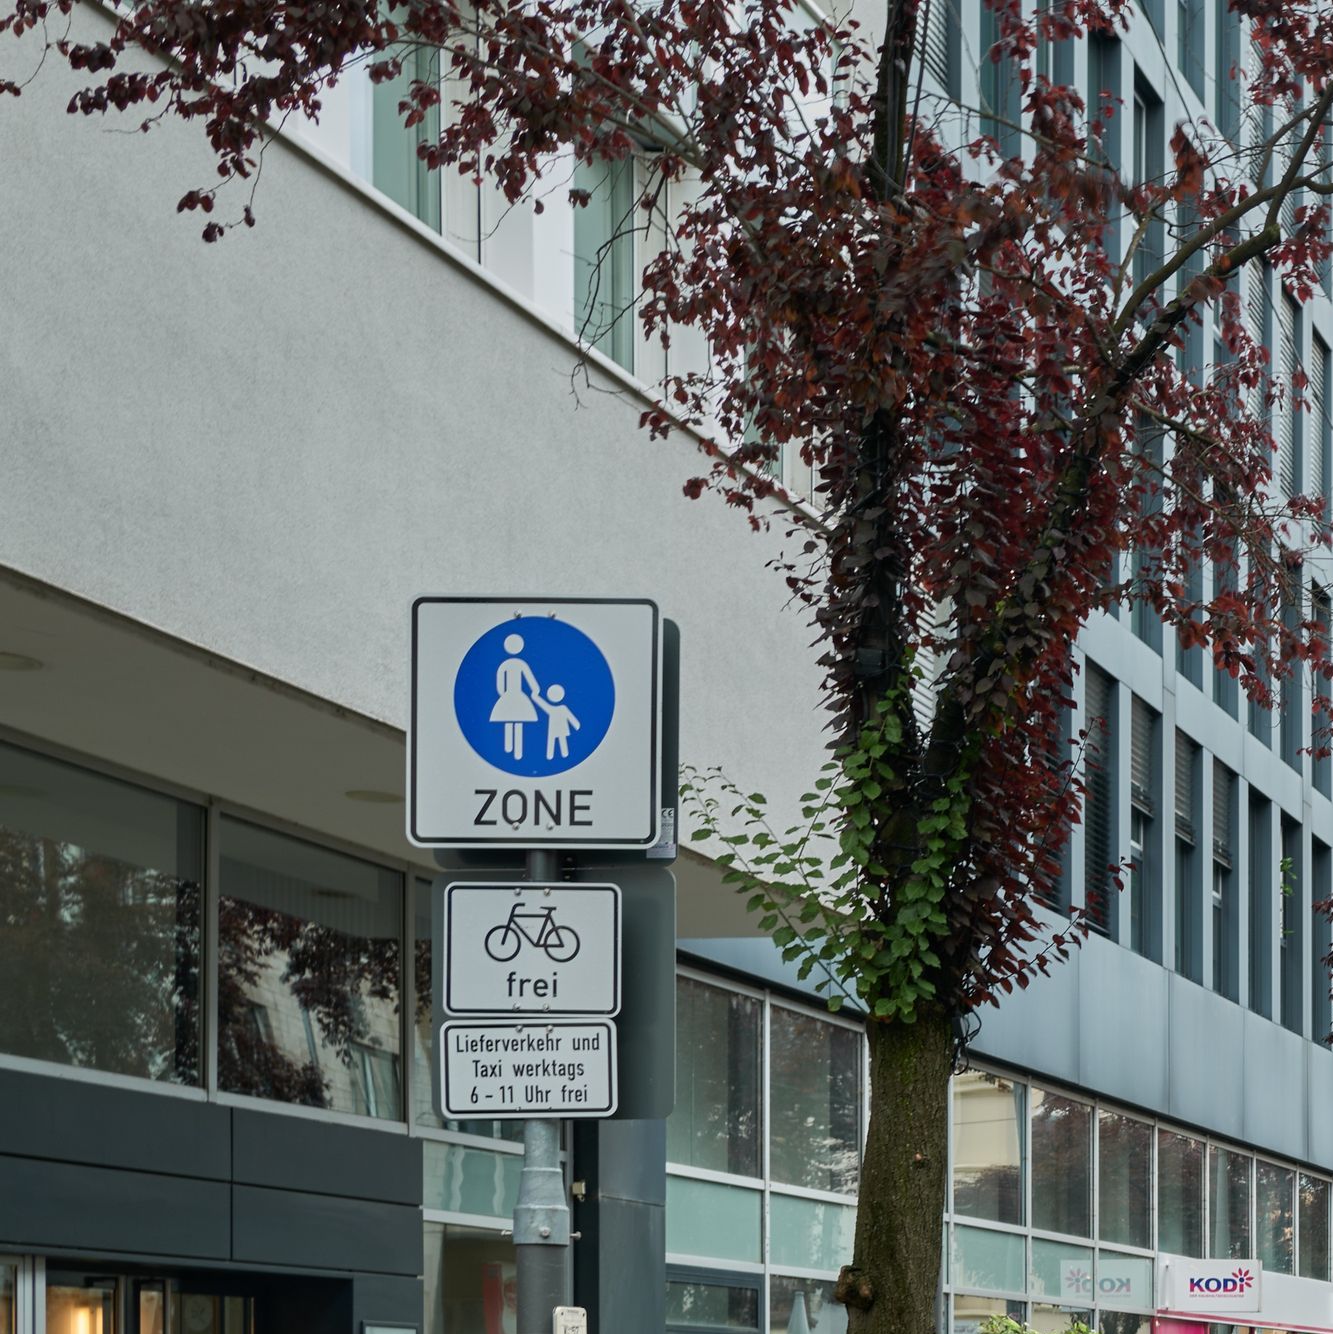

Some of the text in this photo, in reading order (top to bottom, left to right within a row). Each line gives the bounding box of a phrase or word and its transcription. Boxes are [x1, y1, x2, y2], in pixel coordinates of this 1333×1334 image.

[473, 789, 594, 826] ZONE
[506, 971, 558, 998] frei
[455, 1033, 600, 1053] Lieferverkehr und
[472, 1059, 585, 1081] Taxi werktags
[470, 1087, 479, 1104] 6
[499, 1087, 516, 1104] 11
[525, 1086, 552, 1104] Uhr
[560, 1084, 589, 1103] frei
